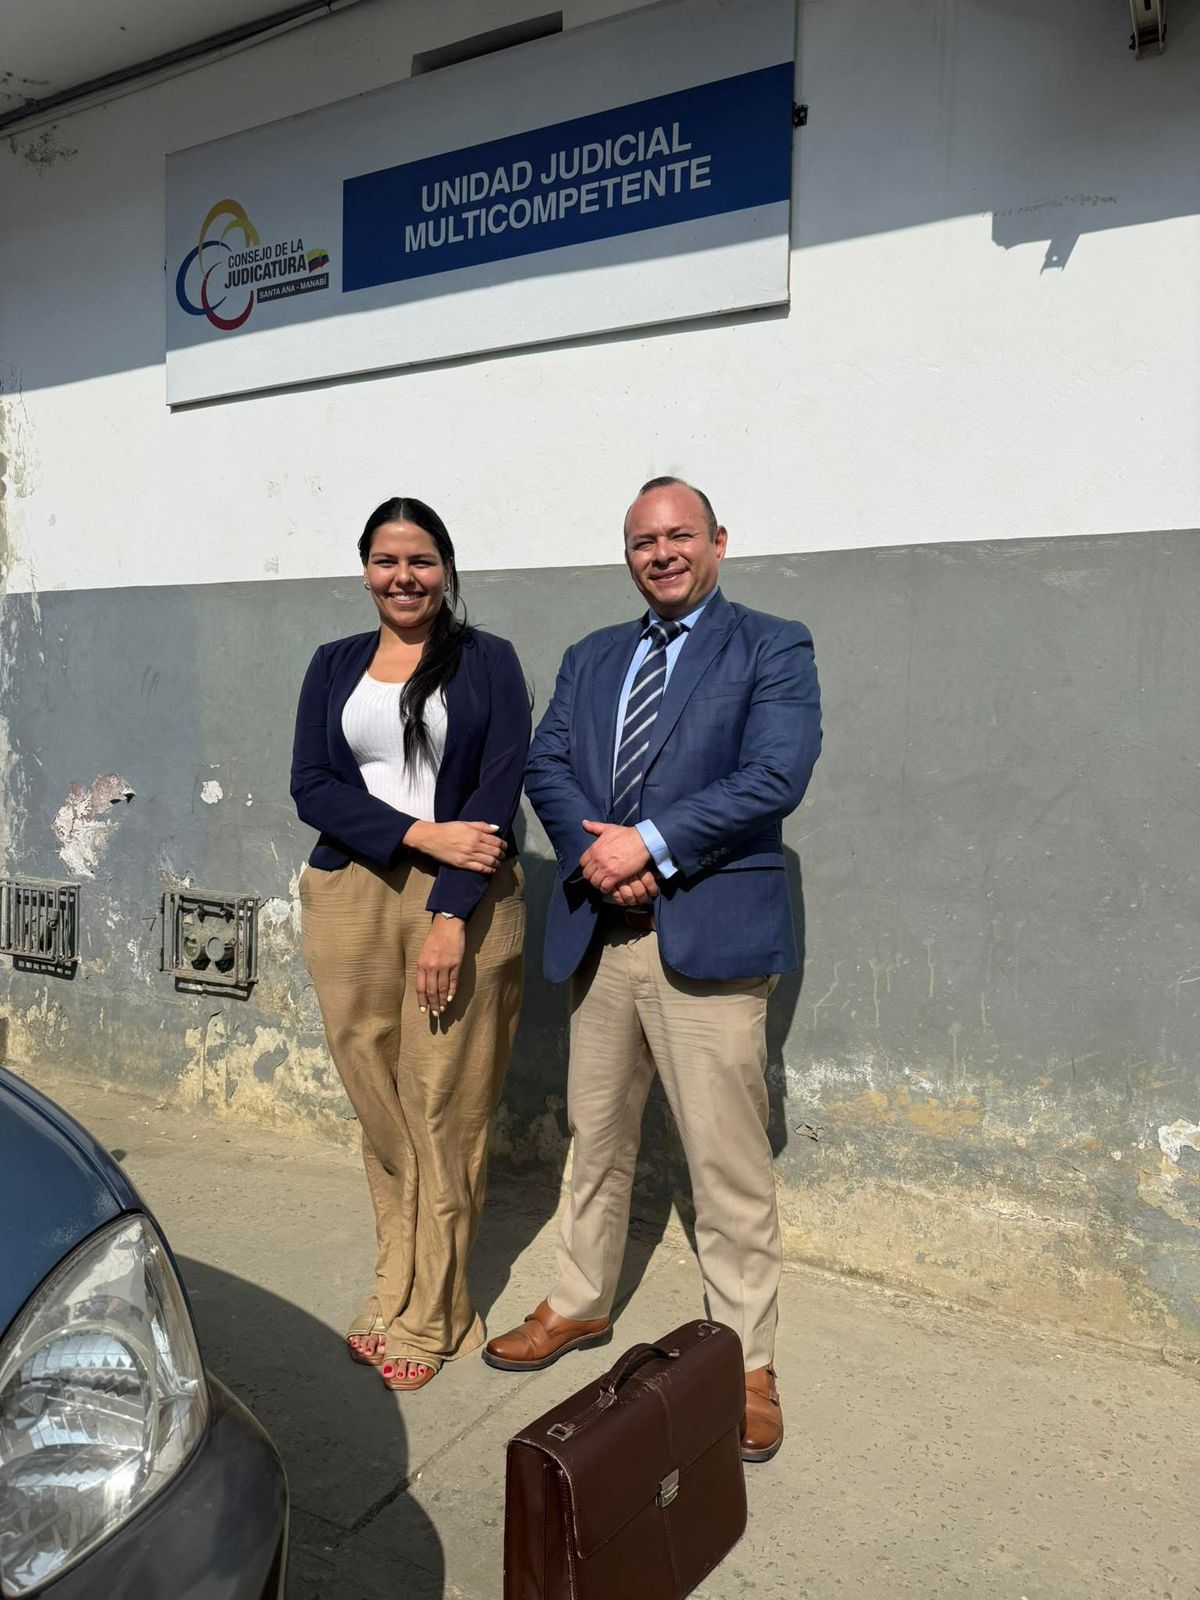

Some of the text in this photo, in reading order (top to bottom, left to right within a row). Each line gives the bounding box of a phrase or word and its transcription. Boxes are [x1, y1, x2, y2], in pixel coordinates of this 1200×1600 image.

[421, 122, 692, 213] UNIDAD JUDICIAL
[405, 155, 712, 253] MULTICOMPETENTE
[228, 238, 304, 269] CONSEJO DE LA
[224, 254, 307, 289] JUDICATURA
[259, 289, 281, 299] SANTA
[281, 285, 295, 294] ANA
